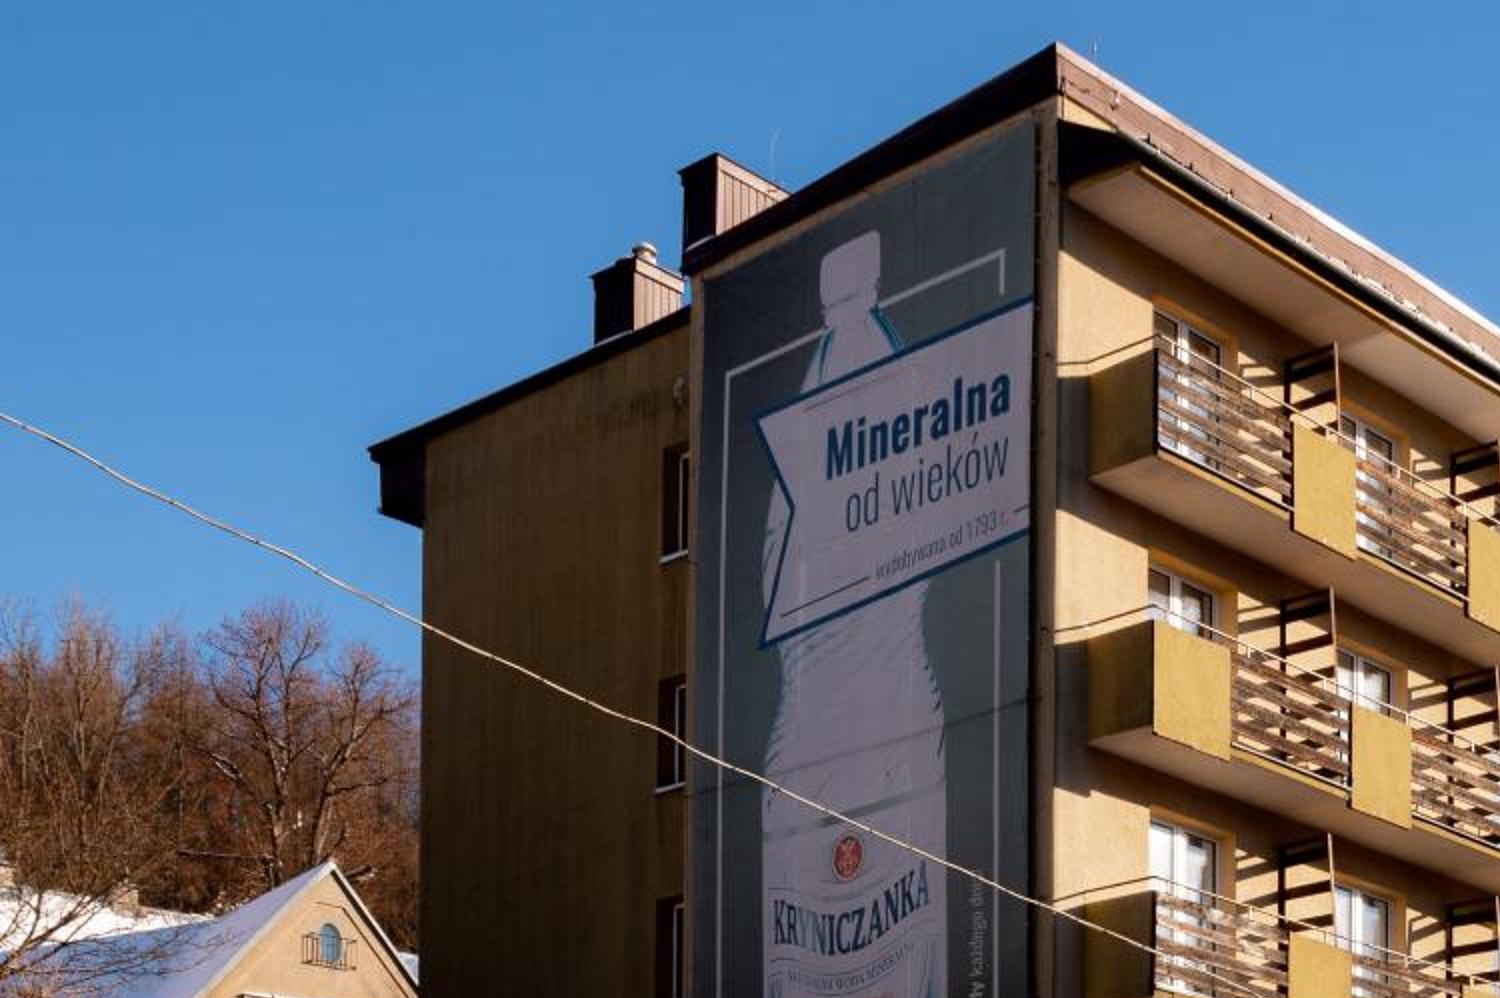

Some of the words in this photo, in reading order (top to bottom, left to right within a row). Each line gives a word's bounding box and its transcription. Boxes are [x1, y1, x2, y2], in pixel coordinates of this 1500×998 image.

[827, 374, 1010, 480] Mineralna
[846, 471, 879, 532] od
[892, 432, 1008, 515] wieków
[949, 524, 963, 546] od
[966, 511, 996, 539] 1793
[773, 860, 929, 956] KRYNICZANKA
